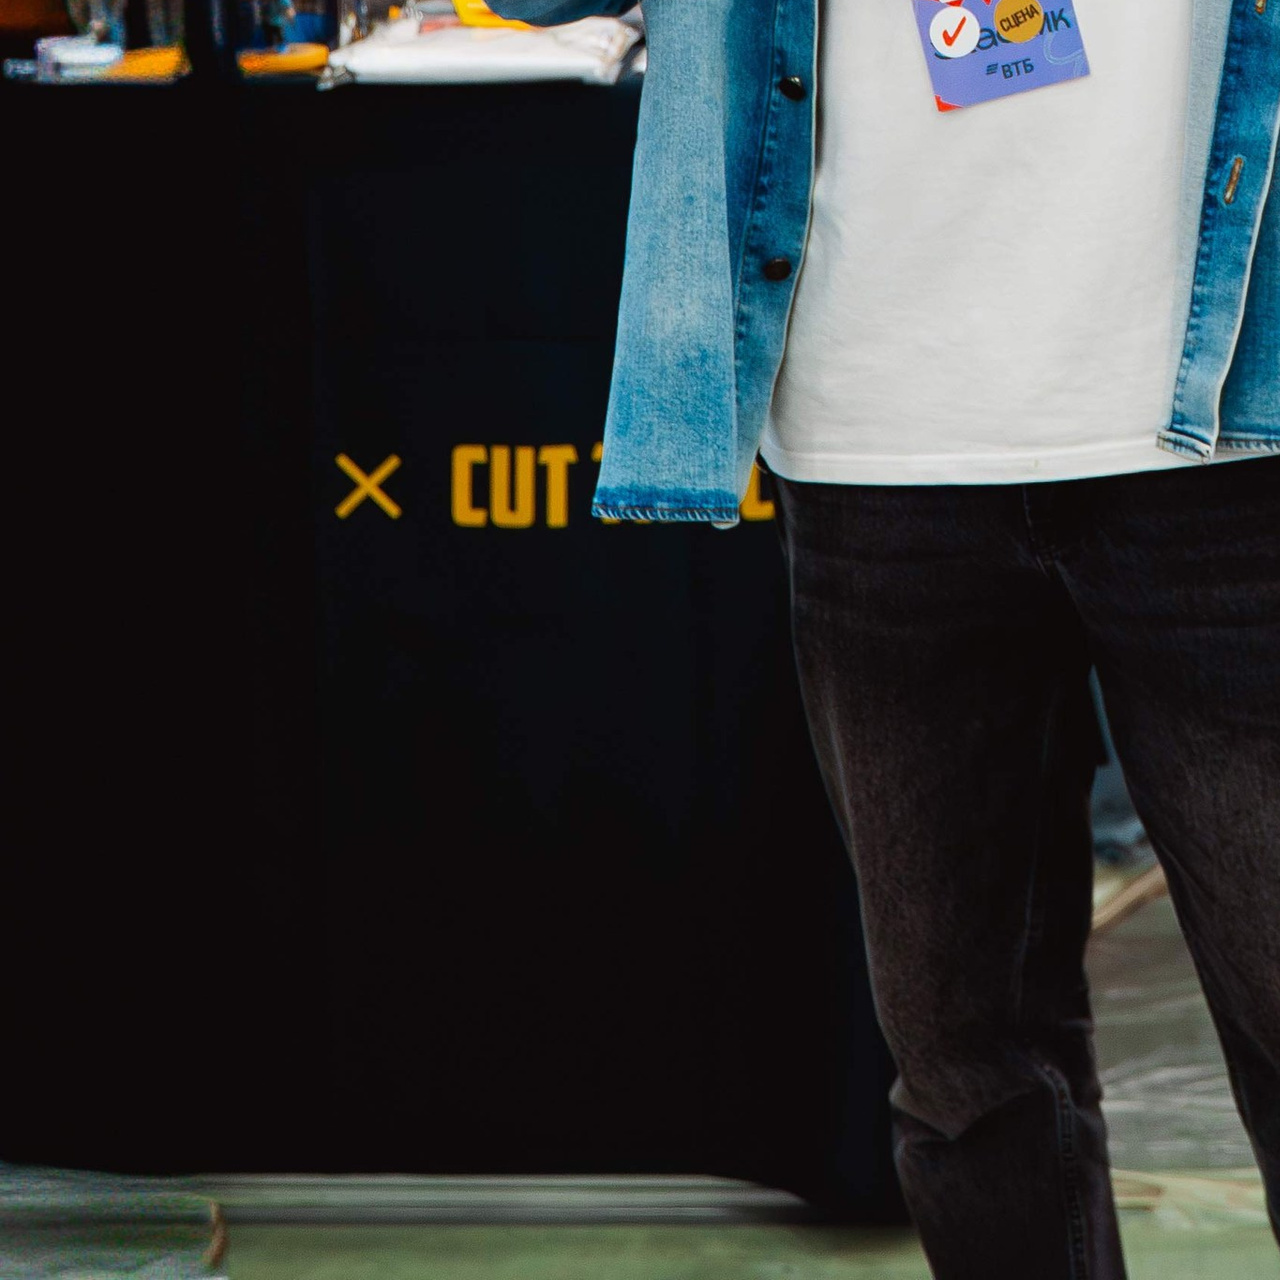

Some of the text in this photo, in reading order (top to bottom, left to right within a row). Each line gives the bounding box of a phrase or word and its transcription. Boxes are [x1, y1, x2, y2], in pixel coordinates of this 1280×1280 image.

[1000, 4, 1039, 32] СЦЕНА
[1002, 58, 1035, 80] ВТБ
[451, 444, 578, 528] CUT
